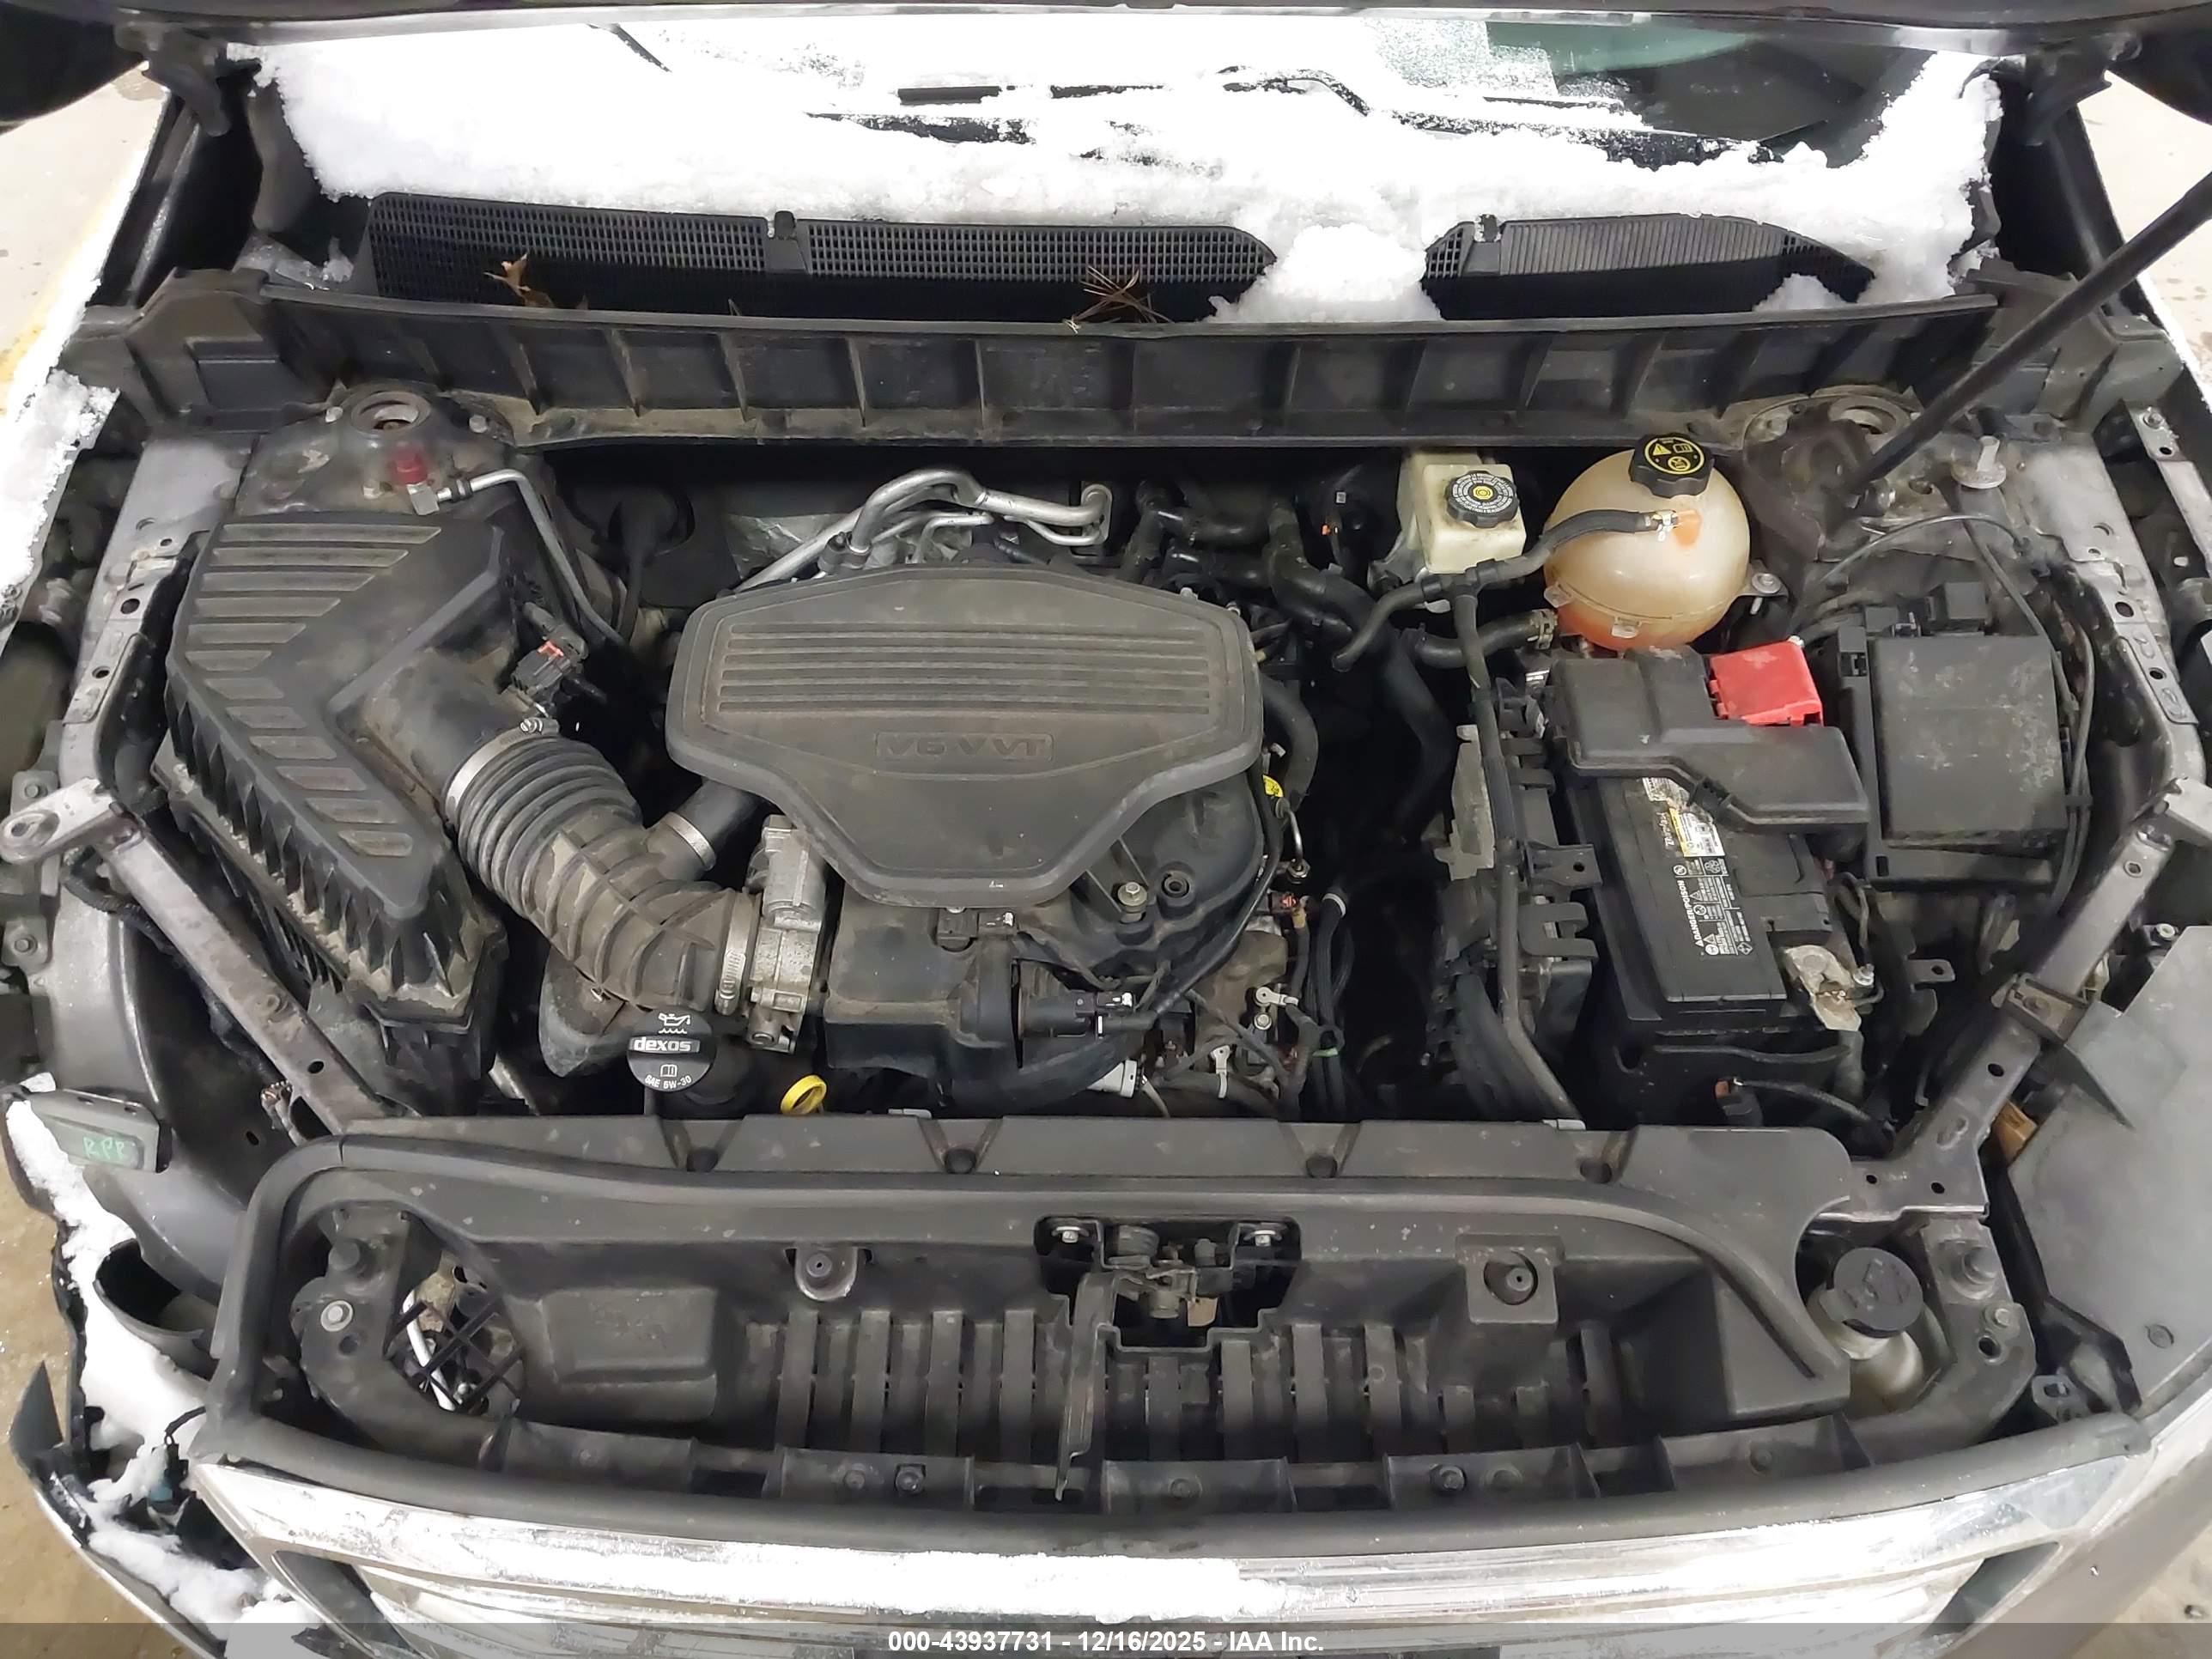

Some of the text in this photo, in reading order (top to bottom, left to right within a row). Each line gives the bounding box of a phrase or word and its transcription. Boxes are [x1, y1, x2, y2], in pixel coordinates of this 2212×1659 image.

[885, 738, 1046, 757] V6 VVT
[1677, 880, 1702, 940] DANGER/POISON
[633, 1036, 692, 1053] dexos
[645, 1074, 660, 1088] SAE
